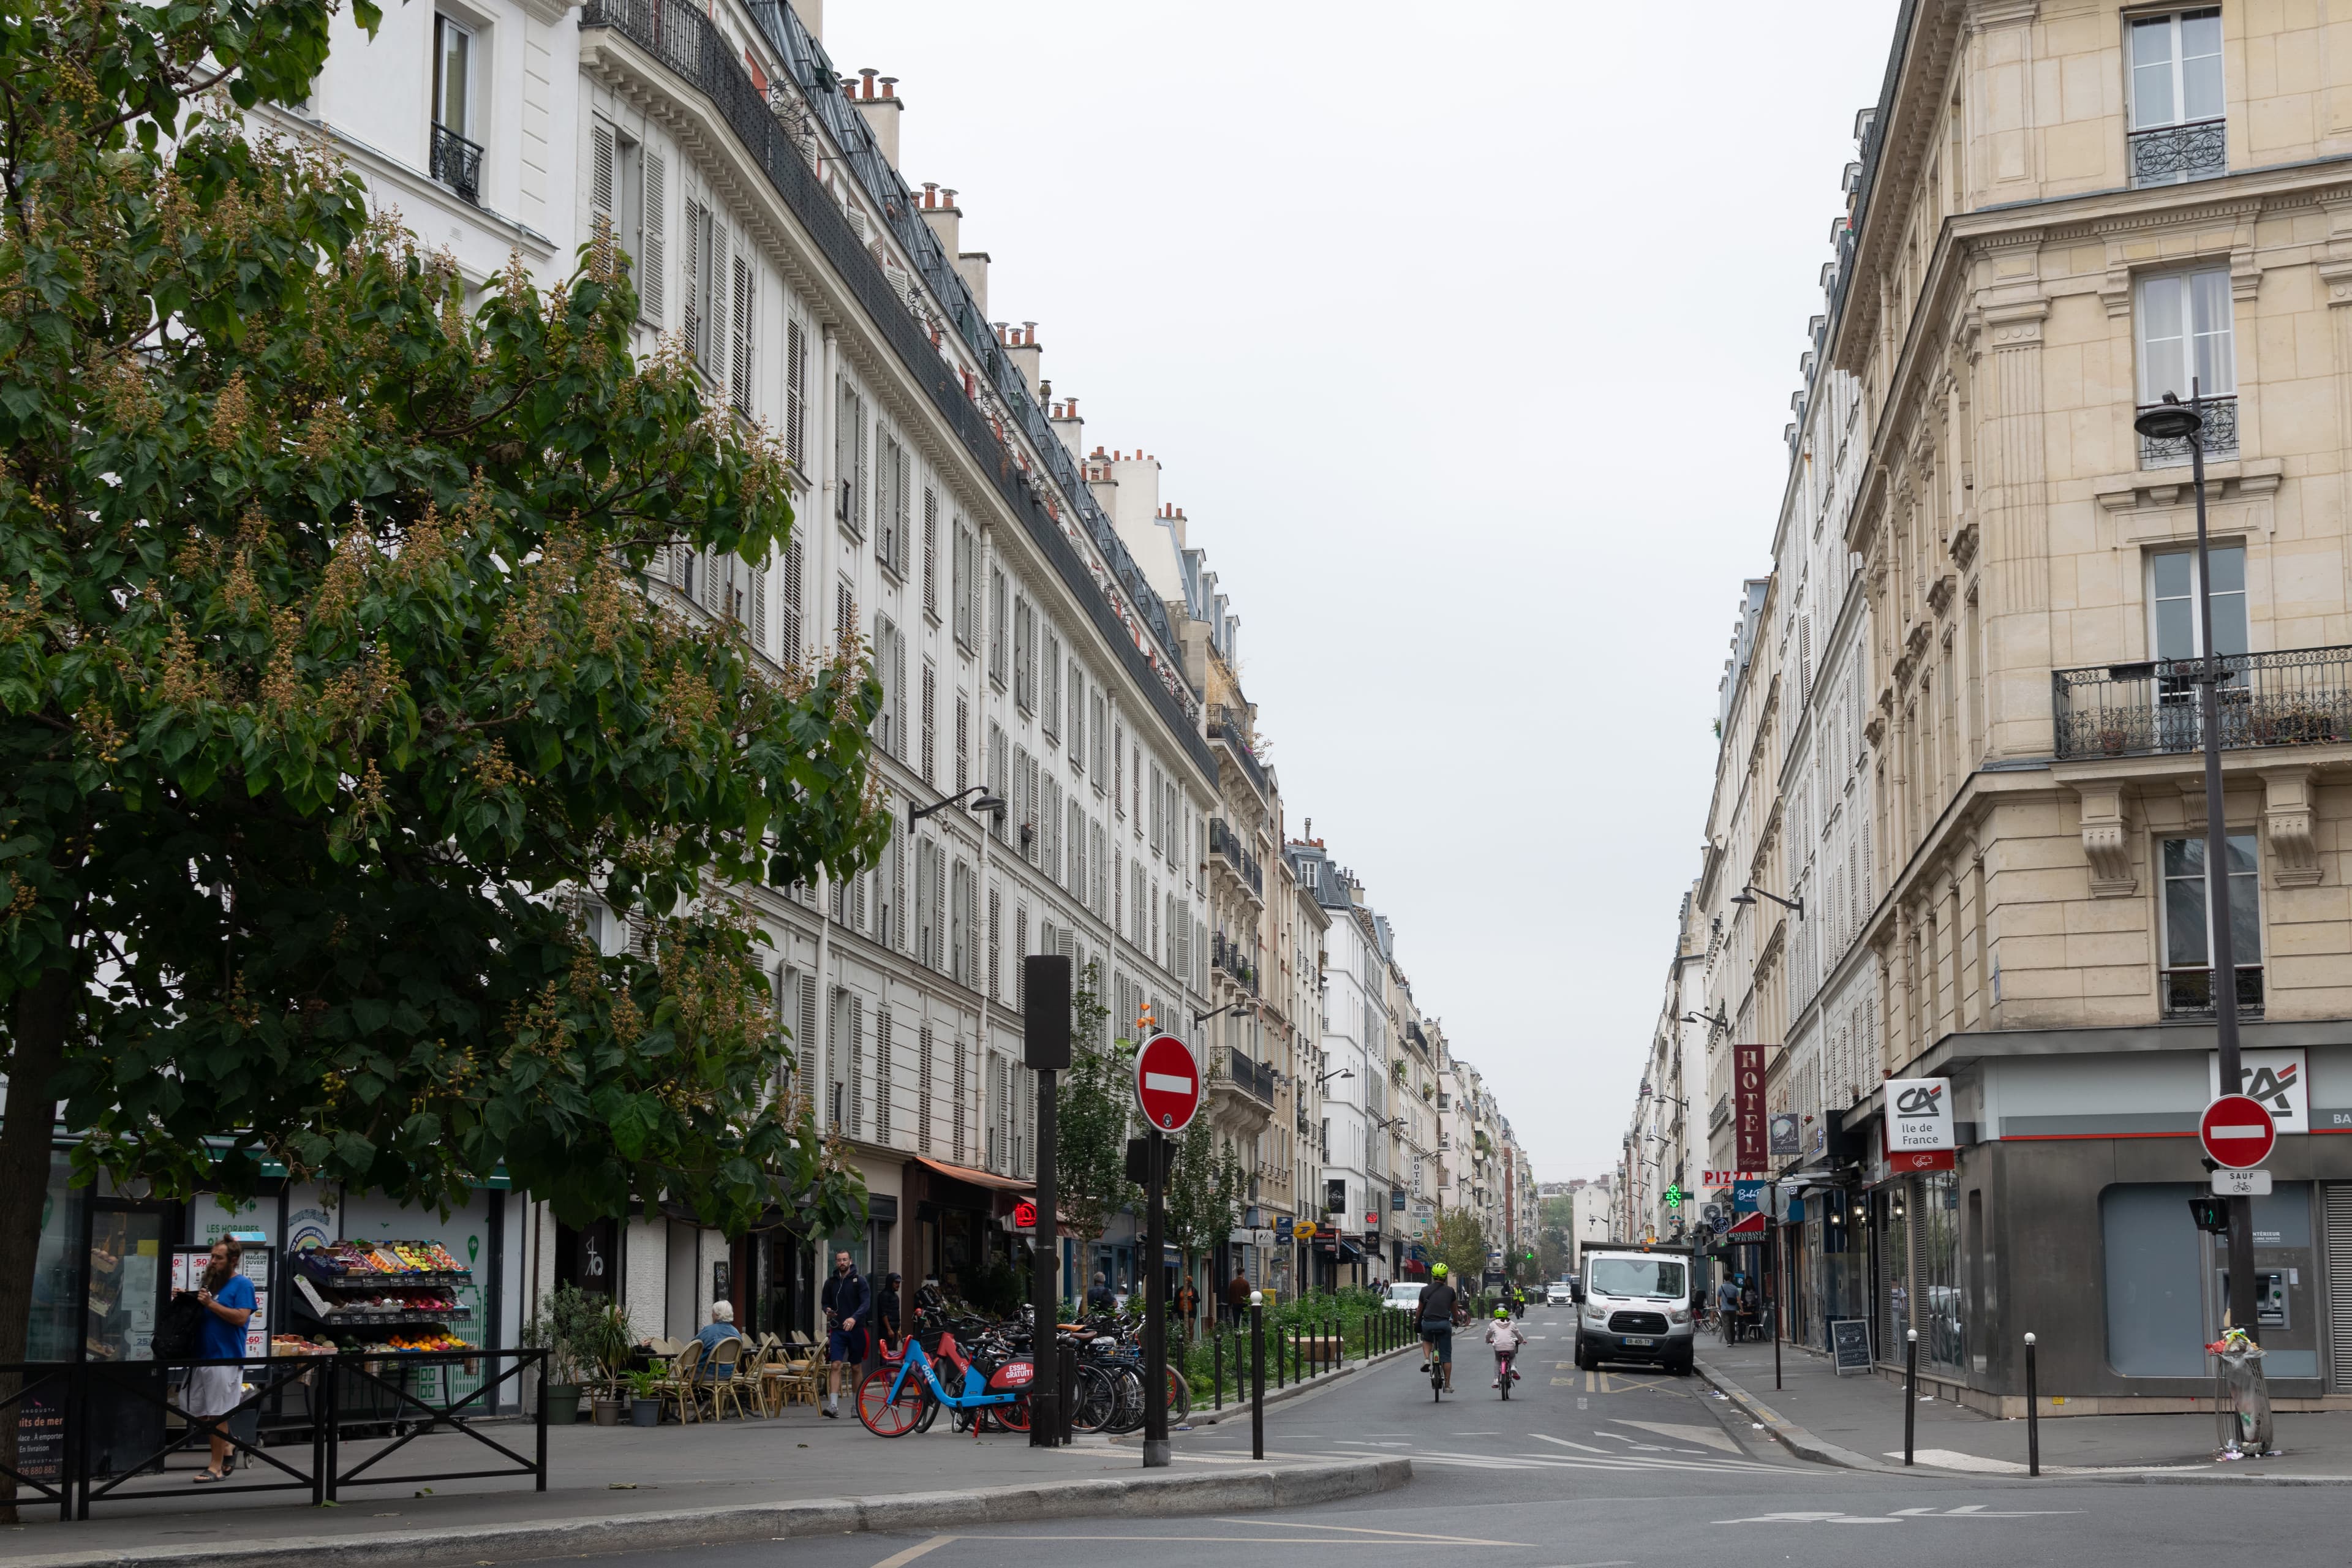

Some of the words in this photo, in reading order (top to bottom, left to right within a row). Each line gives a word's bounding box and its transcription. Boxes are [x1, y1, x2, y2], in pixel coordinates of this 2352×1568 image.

[2241, 1063, 2297, 1109] A
[1741, 1050, 1759, 1153] HOTEL
[1920, 1123, 1932, 1133] de
[1902, 1136, 1939, 1145] France
[206, 1224, 220, 1233] LES
[295, 1229, 316, 1242] PRODUITS
[922, 1364, 935, 1385] dott
[1006, 1369, 1030, 1379] GRATUIT
[34, 1416, 45, 1427] de
[47, 1417, 64, 1426] mer
[39, 1433, 64, 1441] emporter
[30, 1466, 43, 1475] 880
[43, 1464, 56, 1474] 882
